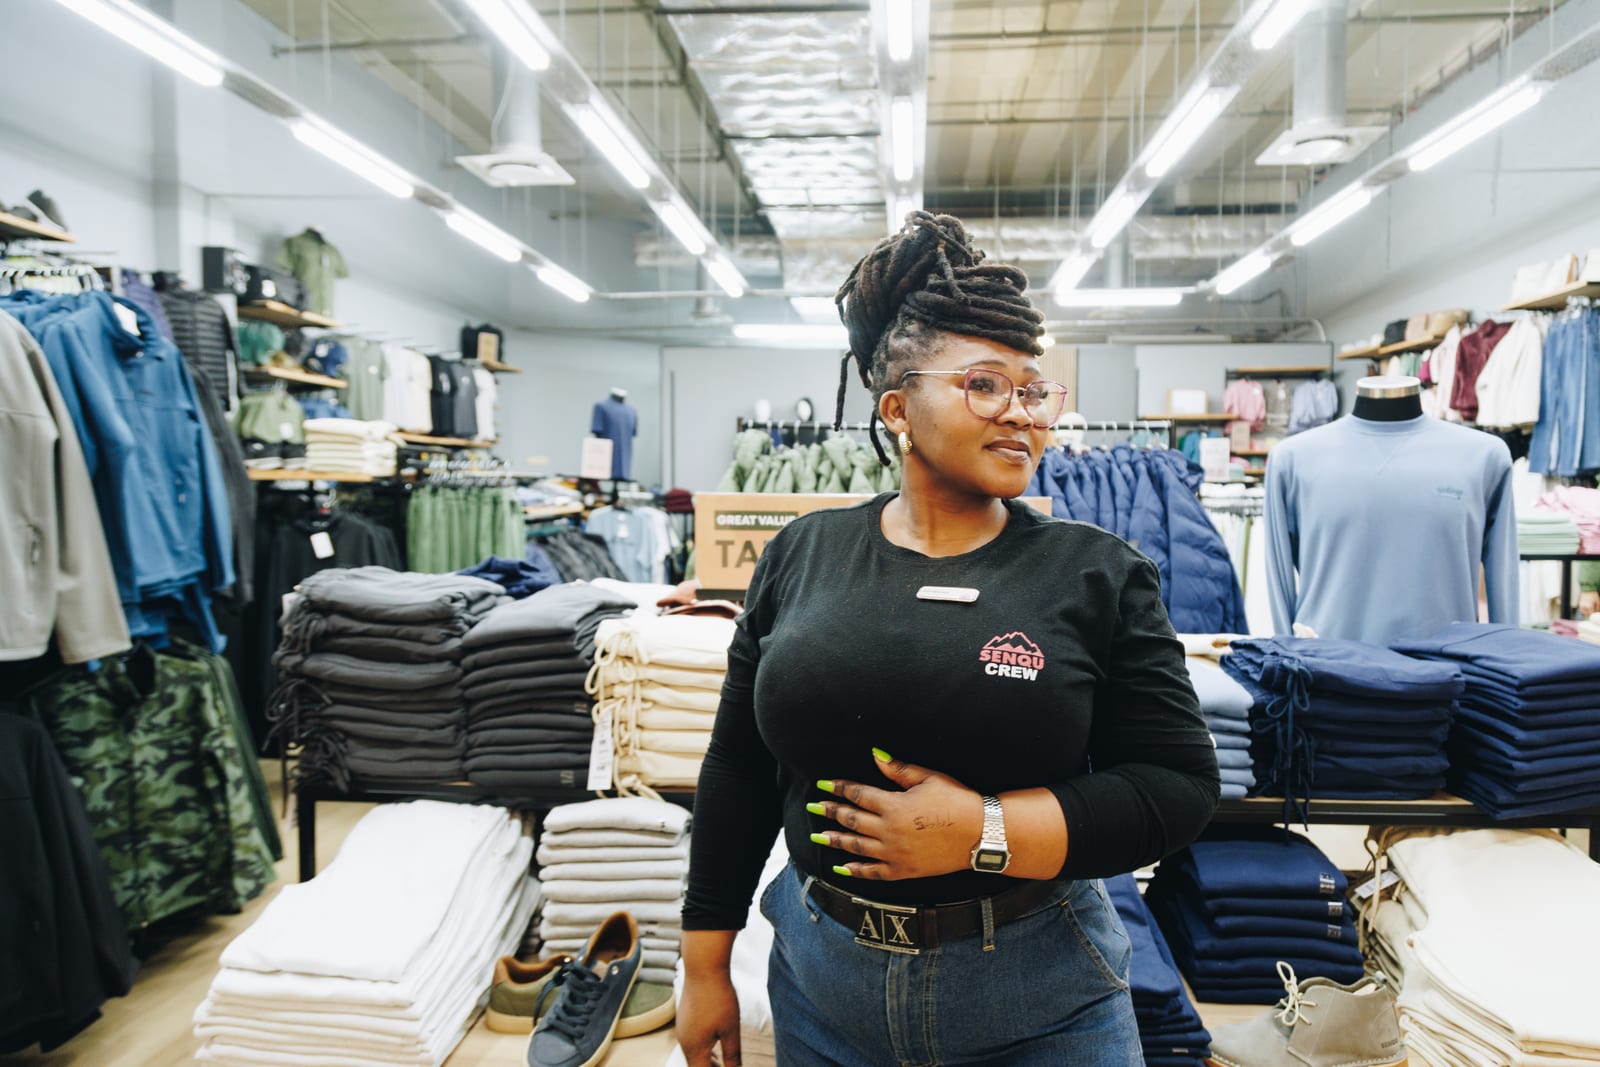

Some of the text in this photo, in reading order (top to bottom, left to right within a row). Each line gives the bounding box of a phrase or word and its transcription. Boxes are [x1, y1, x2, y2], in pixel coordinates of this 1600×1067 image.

[716, 514, 757, 526] GREAT
[979, 649, 1045, 670] SENQU
[984, 662, 1038, 681] CREW
